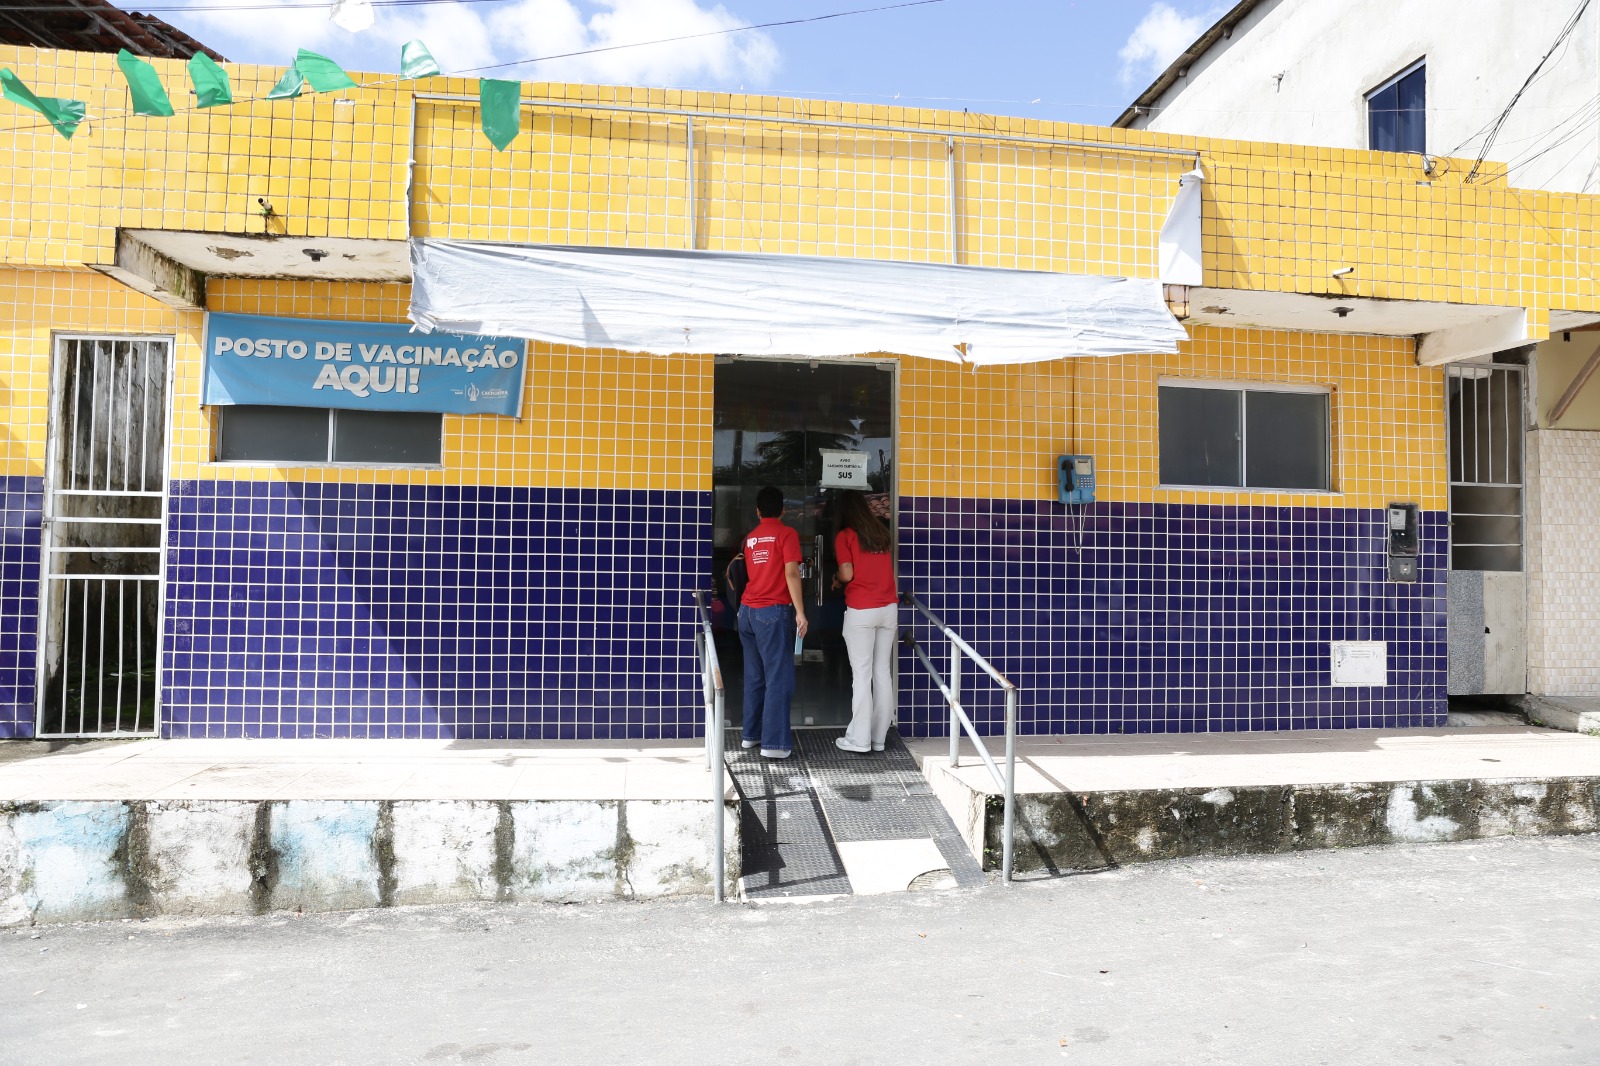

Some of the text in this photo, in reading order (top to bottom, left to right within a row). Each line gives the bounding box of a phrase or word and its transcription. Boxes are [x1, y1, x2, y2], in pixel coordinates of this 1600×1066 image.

[215, 336, 519, 373] POSTO DE VACINAÇÃO
[312, 363, 420, 398] AQUI!
